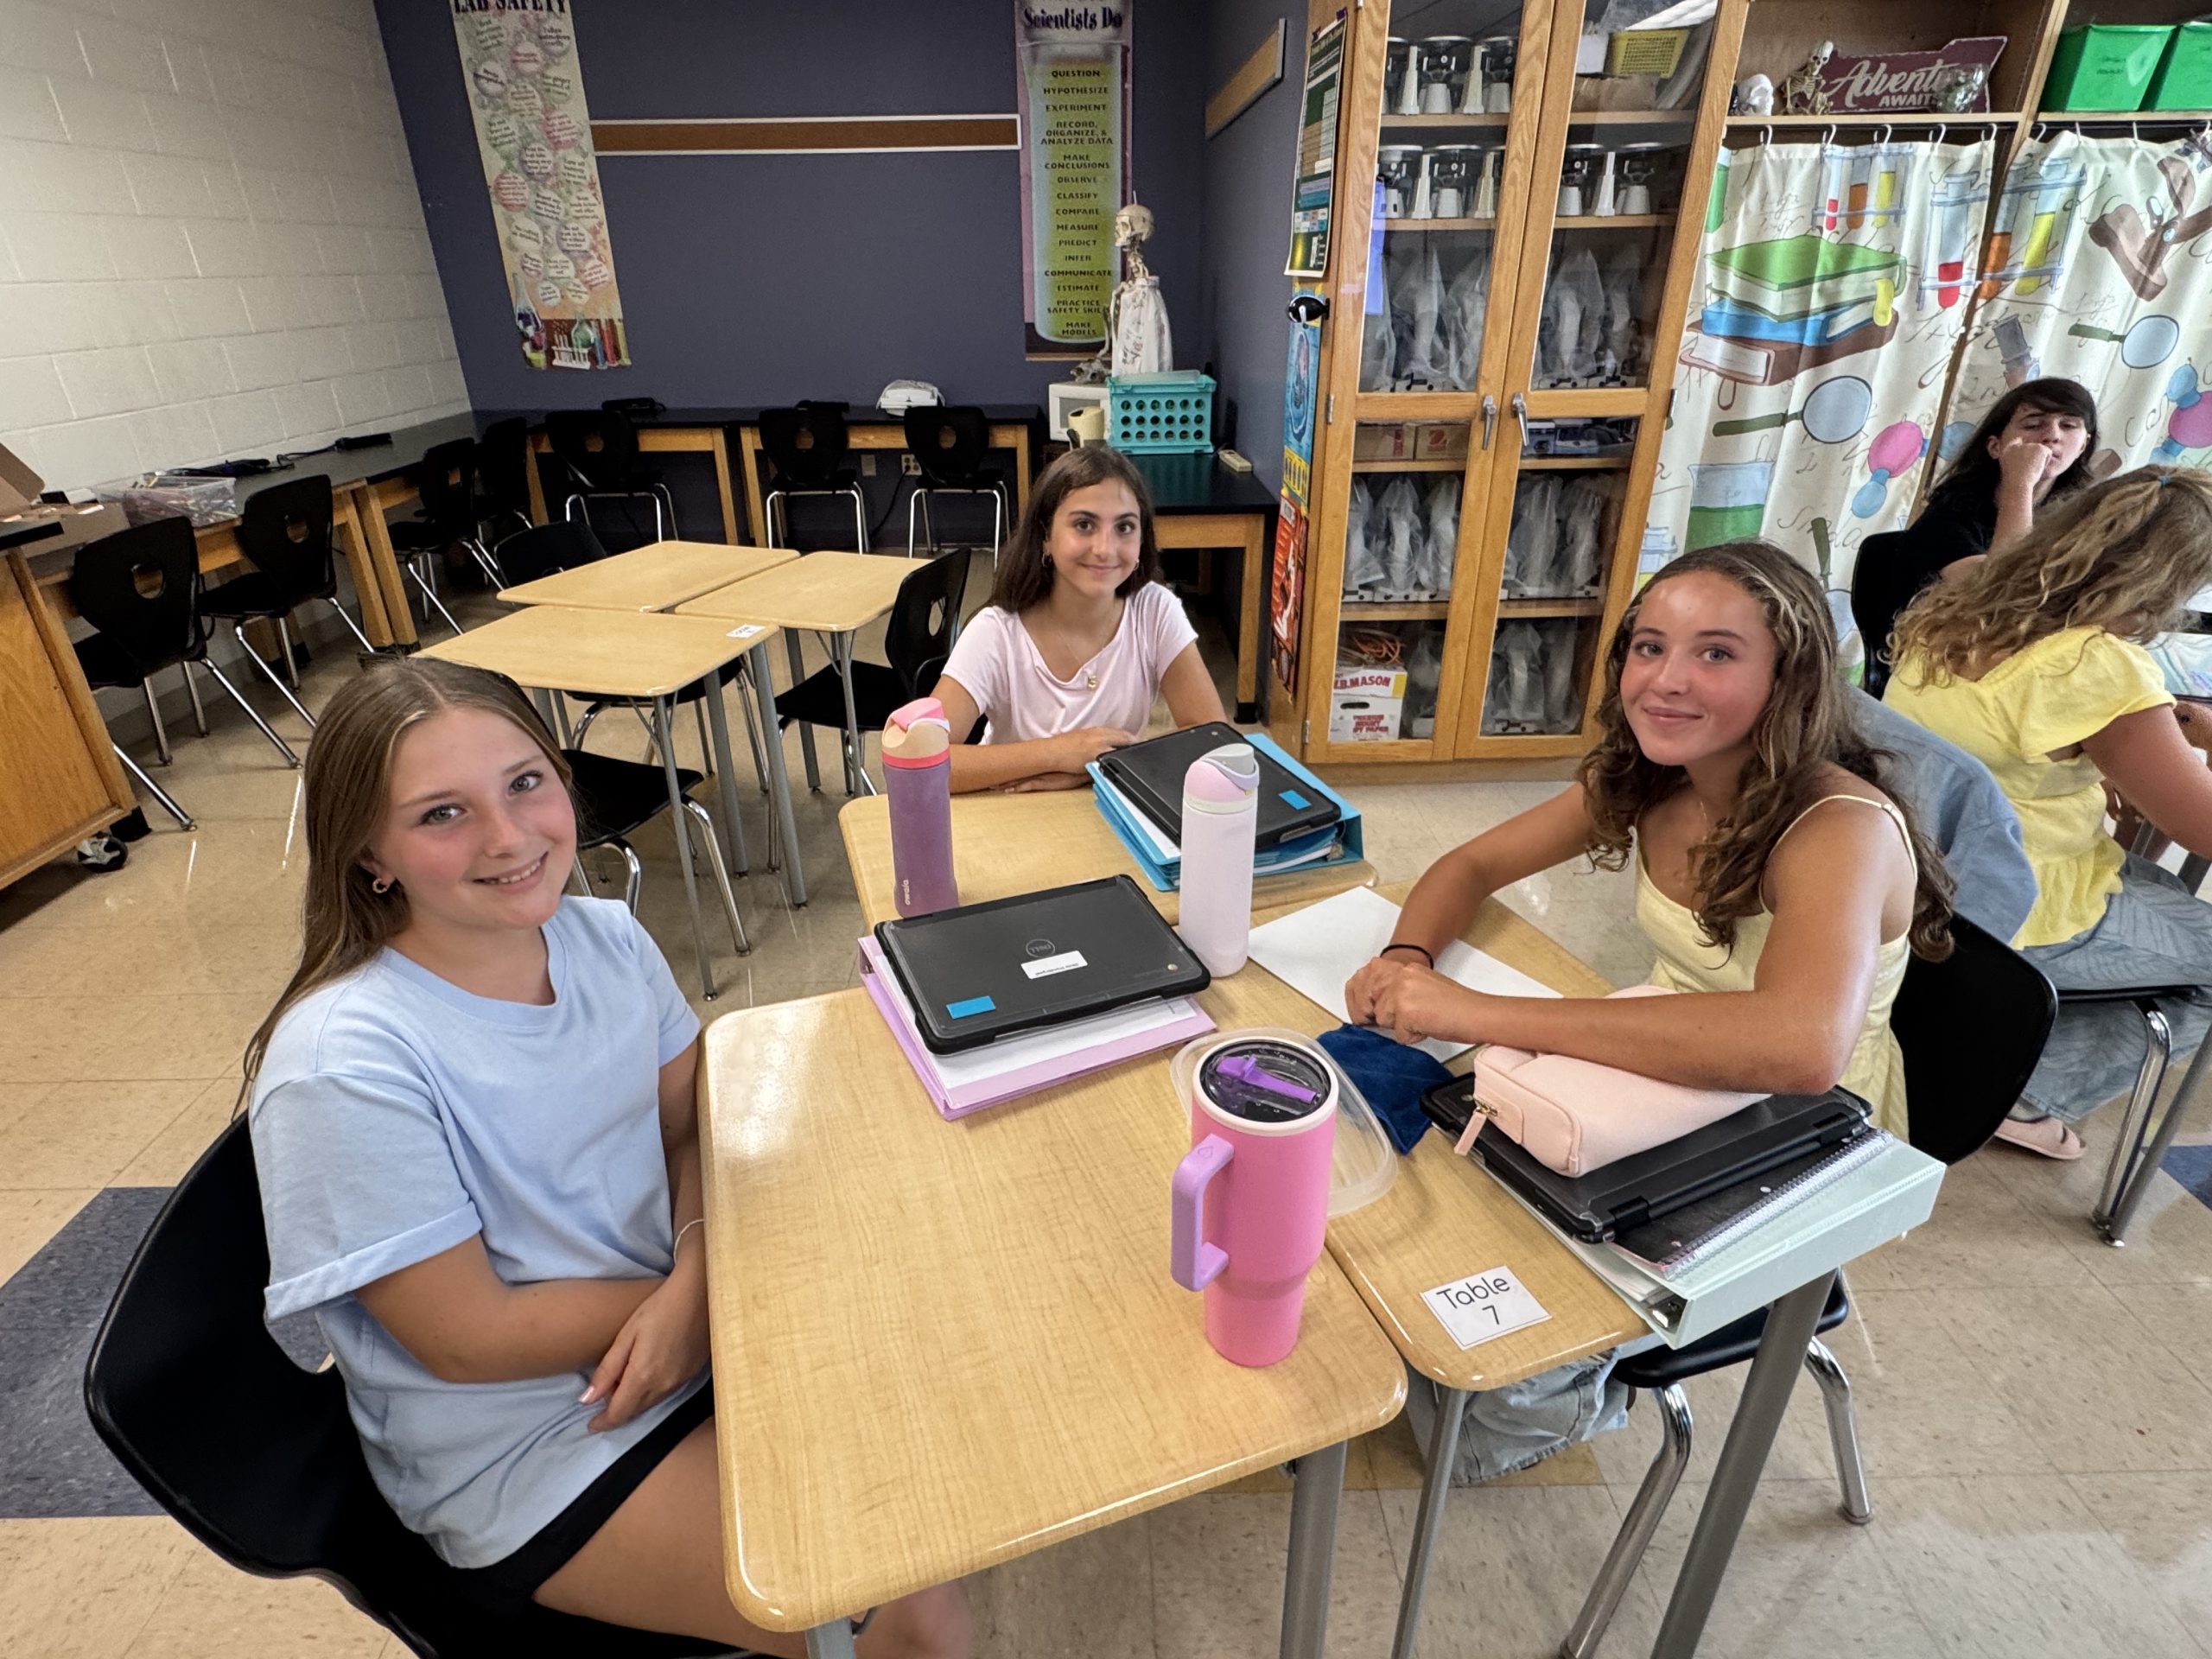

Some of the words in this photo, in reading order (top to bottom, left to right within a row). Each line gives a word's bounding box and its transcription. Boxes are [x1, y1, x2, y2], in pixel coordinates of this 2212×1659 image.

[1024, 8, 1097, 30] Scientists
[1102, 7, 1123, 28] Do
[1825, 59, 1961, 107] Advent
[1878, 93, 1938, 107] AWAIT
[1436, 1277, 1510, 1309] Table
[1482, 1305, 1500, 1325] 7
